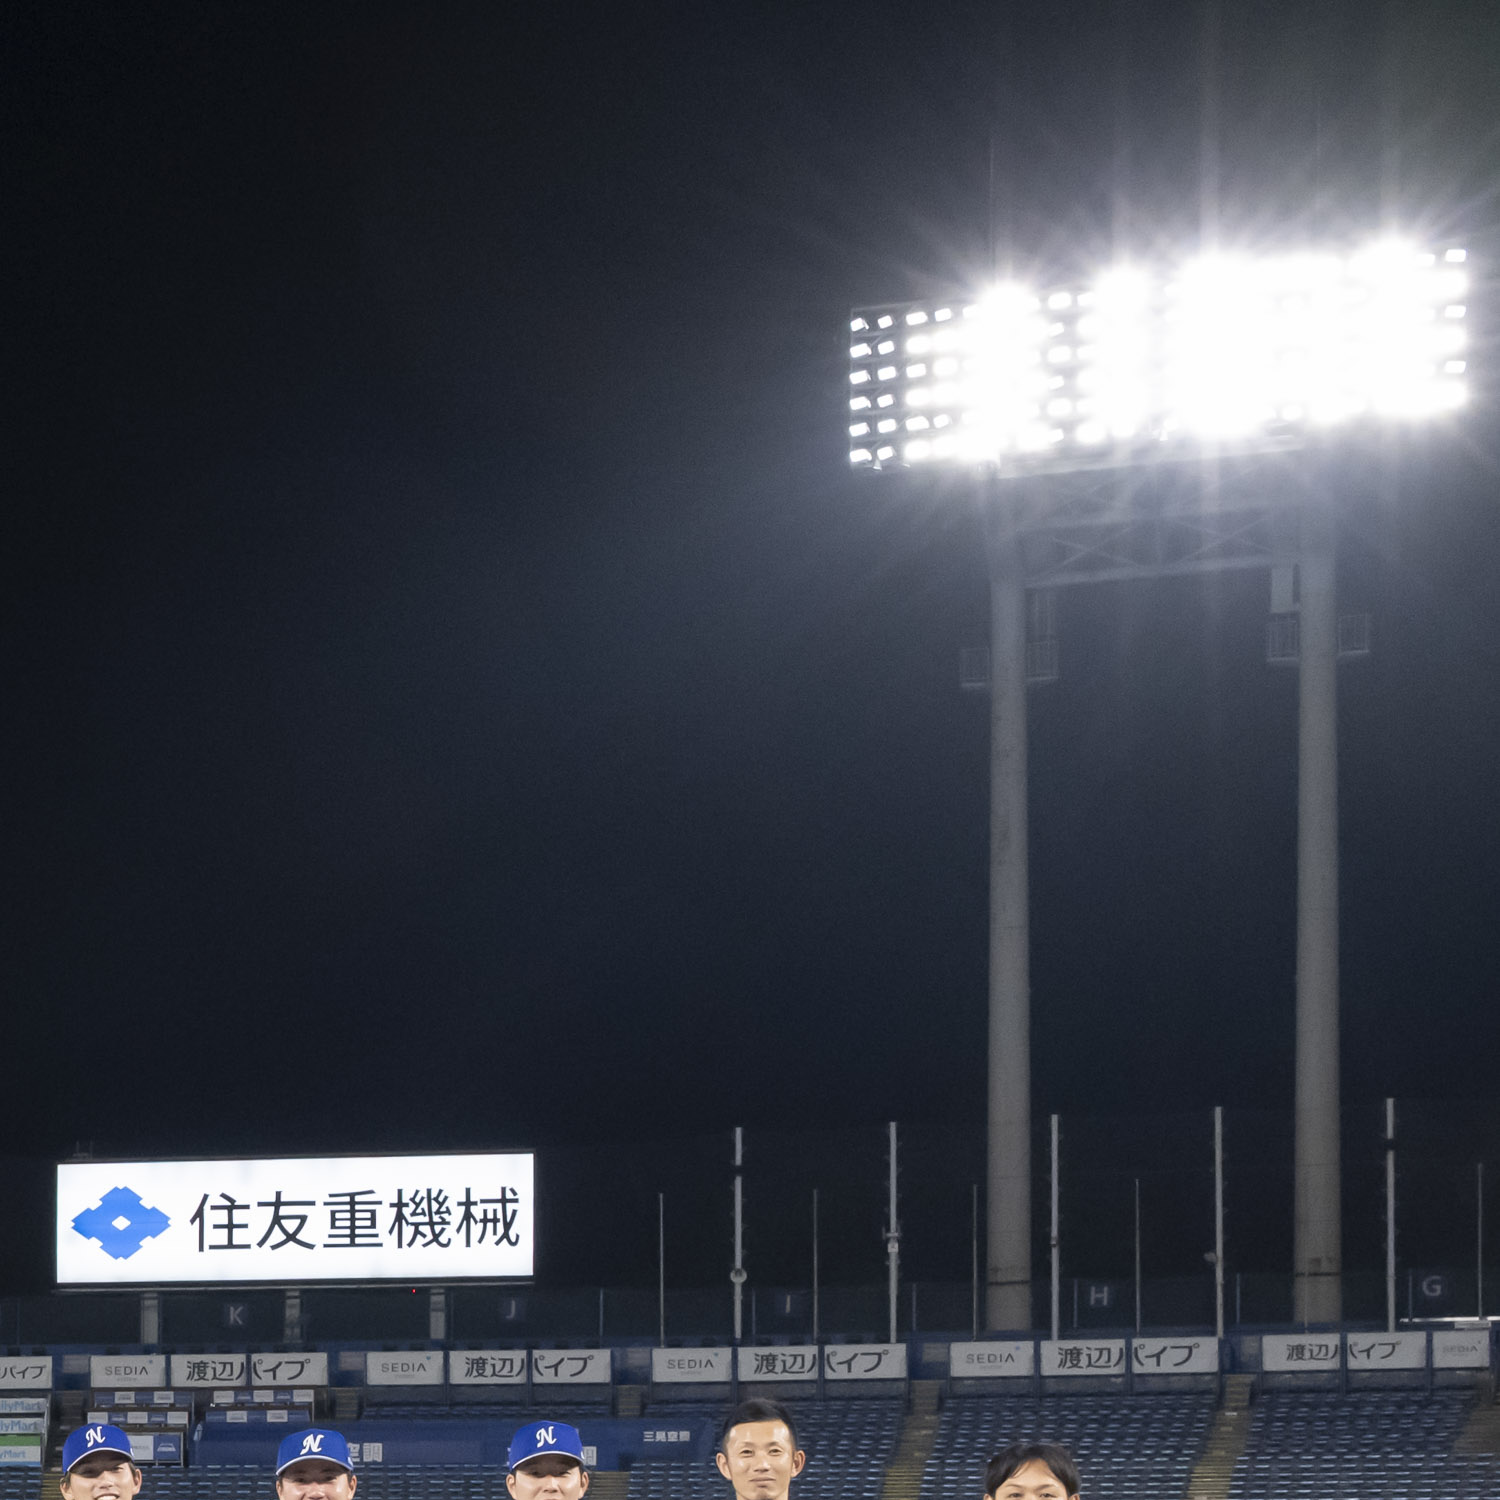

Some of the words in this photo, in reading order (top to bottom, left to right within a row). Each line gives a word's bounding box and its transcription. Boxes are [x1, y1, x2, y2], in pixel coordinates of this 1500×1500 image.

[189, 1186, 520, 1253] 住友重機械
